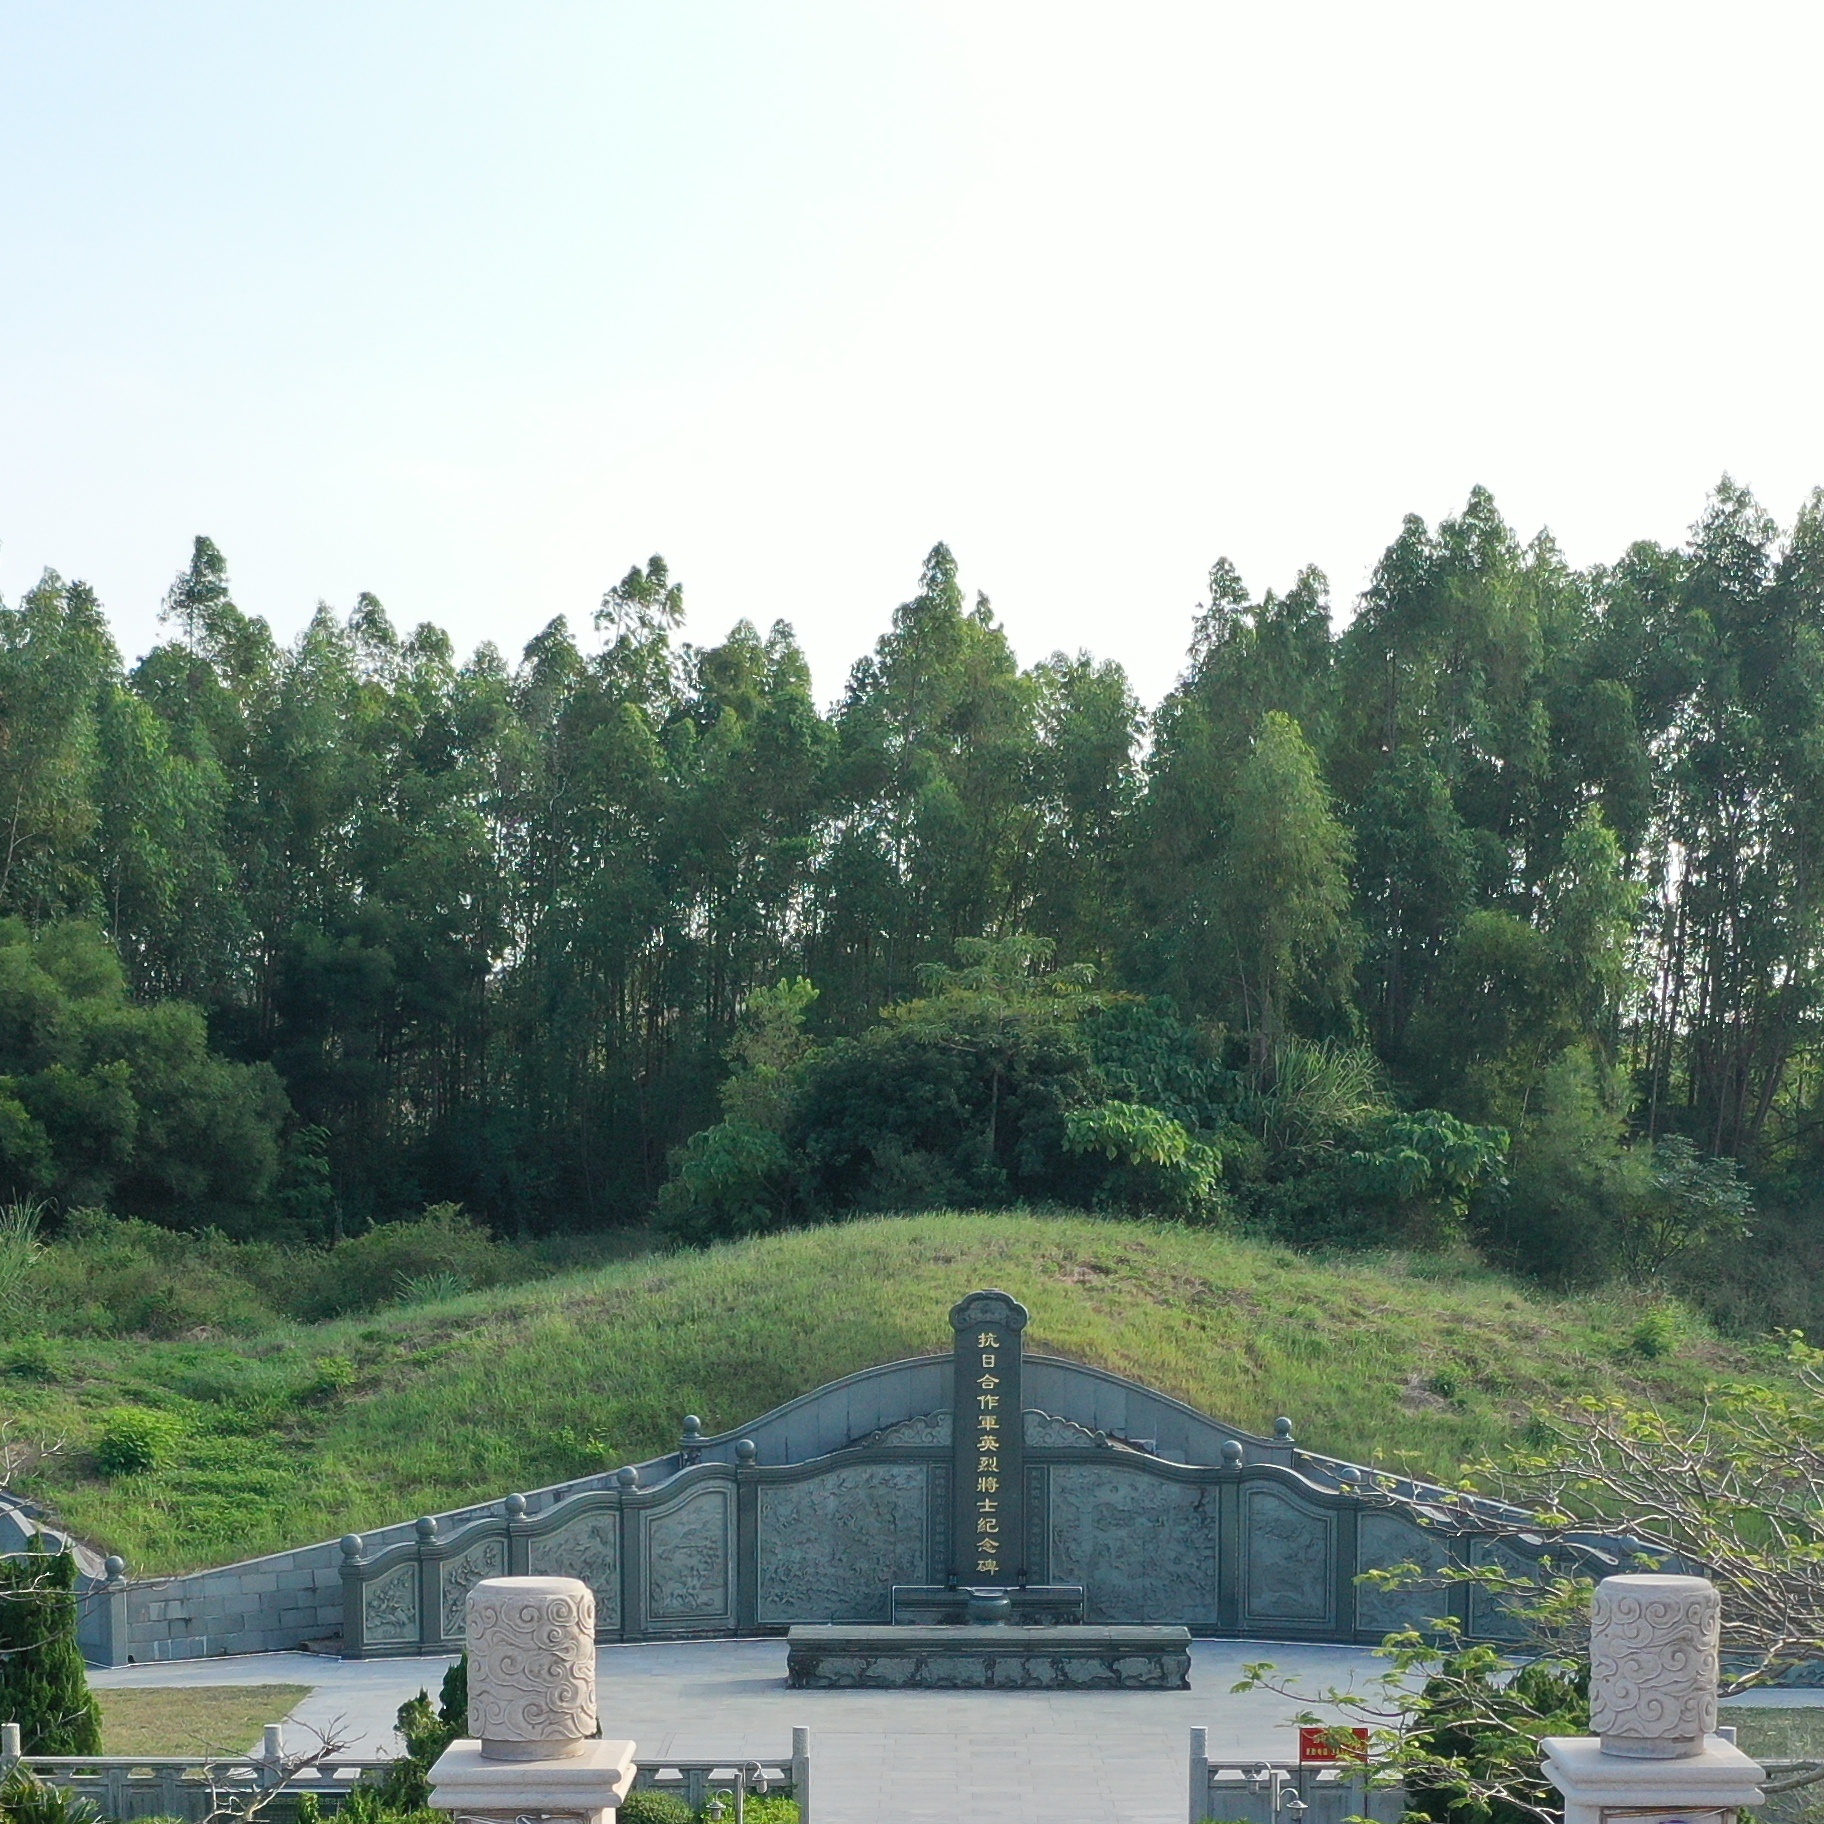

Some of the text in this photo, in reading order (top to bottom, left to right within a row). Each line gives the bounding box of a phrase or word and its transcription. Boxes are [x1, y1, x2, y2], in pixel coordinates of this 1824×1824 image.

[976, 1332, 1001, 1577] 抗日合作軍英烈將士紀念碑
